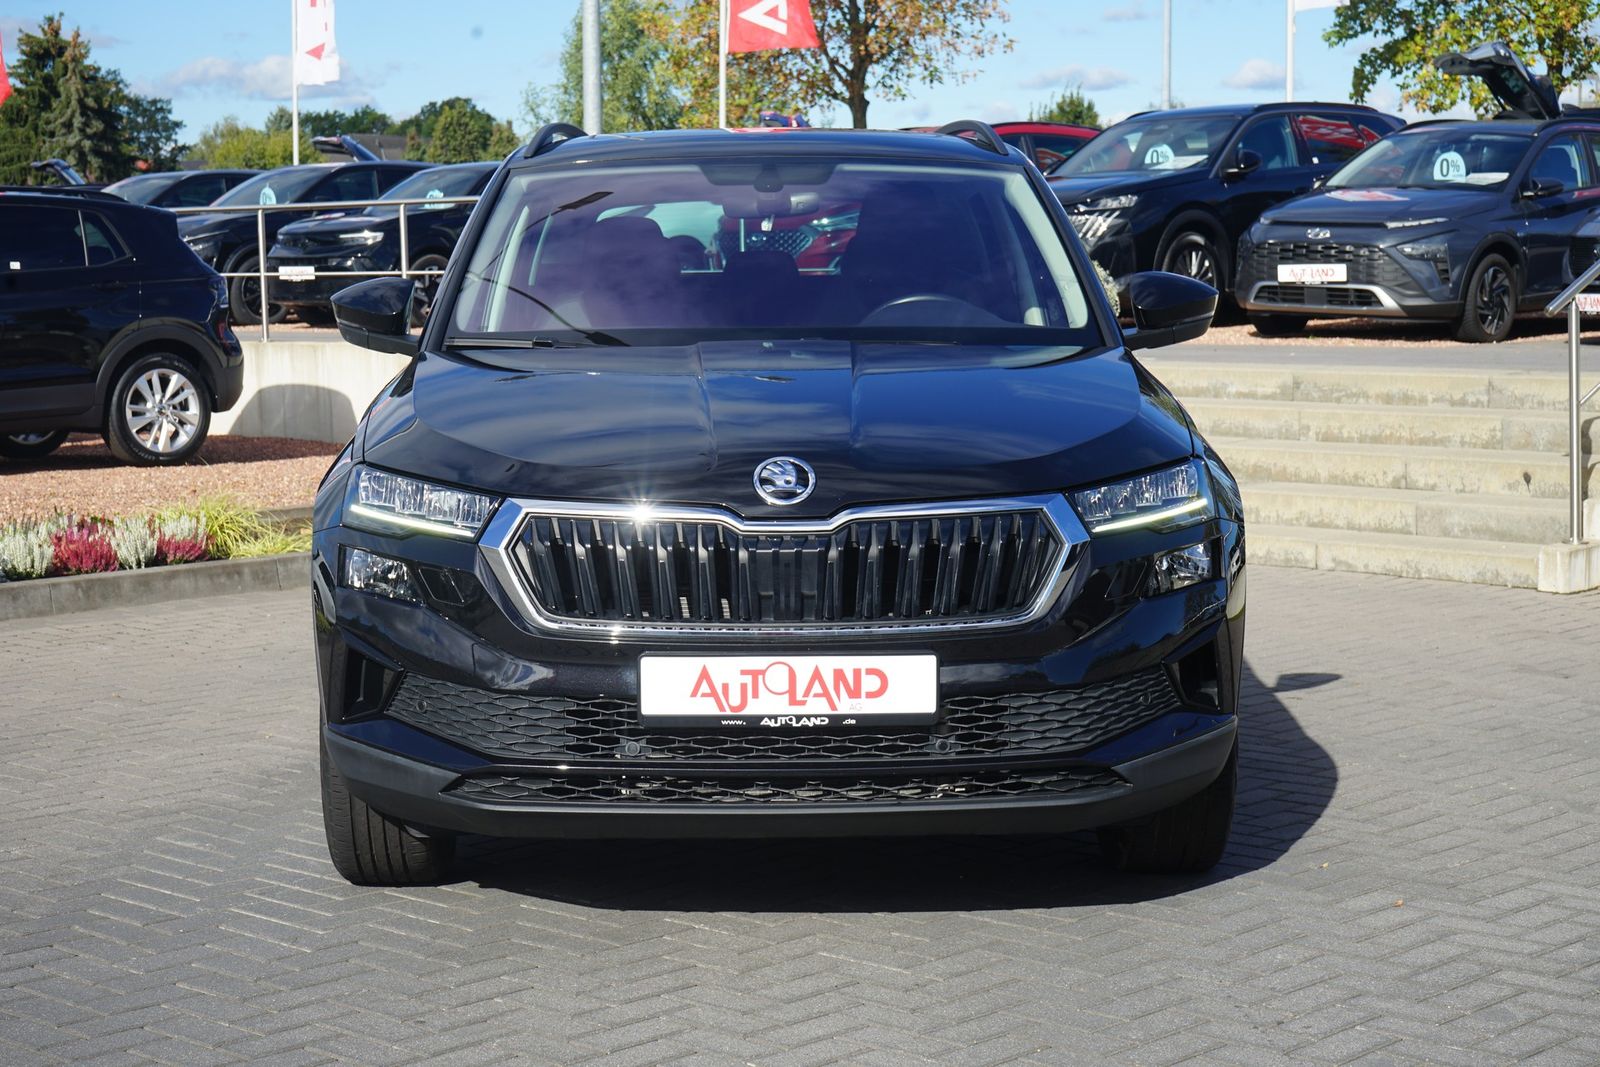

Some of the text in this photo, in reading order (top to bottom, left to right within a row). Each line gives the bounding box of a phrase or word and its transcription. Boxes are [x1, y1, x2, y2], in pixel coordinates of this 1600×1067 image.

[1440, 157, 1460, 177] 0%
[689, 661, 888, 713] AUTOLAND
[849, 702, 863, 711] AG
[760, 716, 829, 727] AUTOLAND
